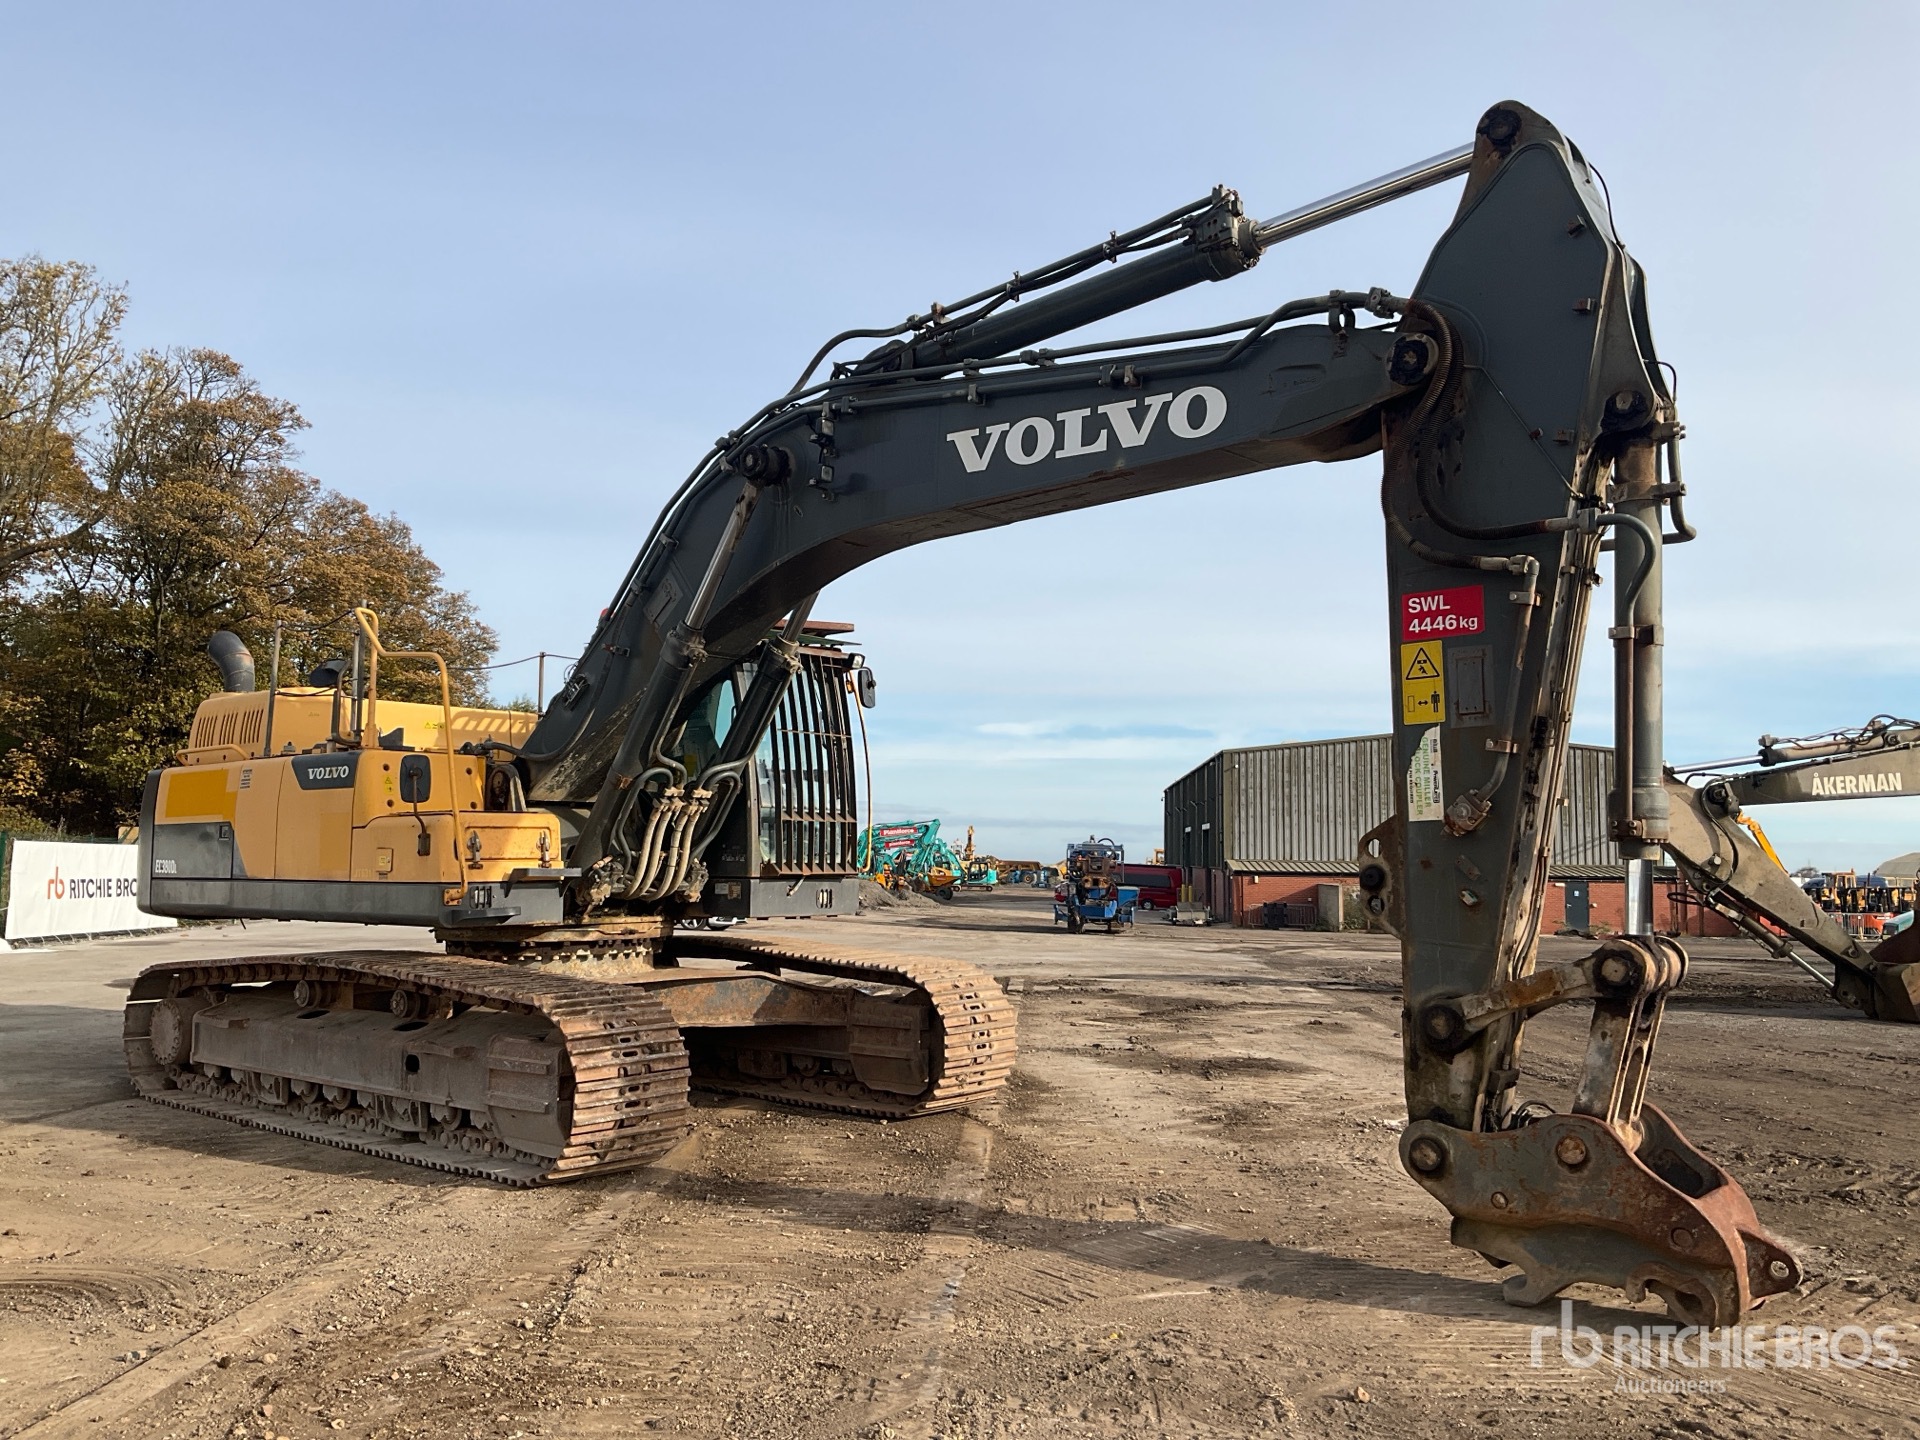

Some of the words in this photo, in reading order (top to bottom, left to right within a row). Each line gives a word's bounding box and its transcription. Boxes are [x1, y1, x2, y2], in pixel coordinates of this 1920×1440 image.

[947, 386, 1228, 473] VOLVO
[1408, 595, 1451, 613] SWL
[1421, 736, 1431, 775] GENUINE
[307, 765, 350, 780] VOLVO
[1811, 772, 1902, 796] ÅKERMAN
[1415, 775, 1424, 816] COUPLER
[1423, 776, 1432, 808] MILLER
[69, 878, 112, 899] RITCHIE
